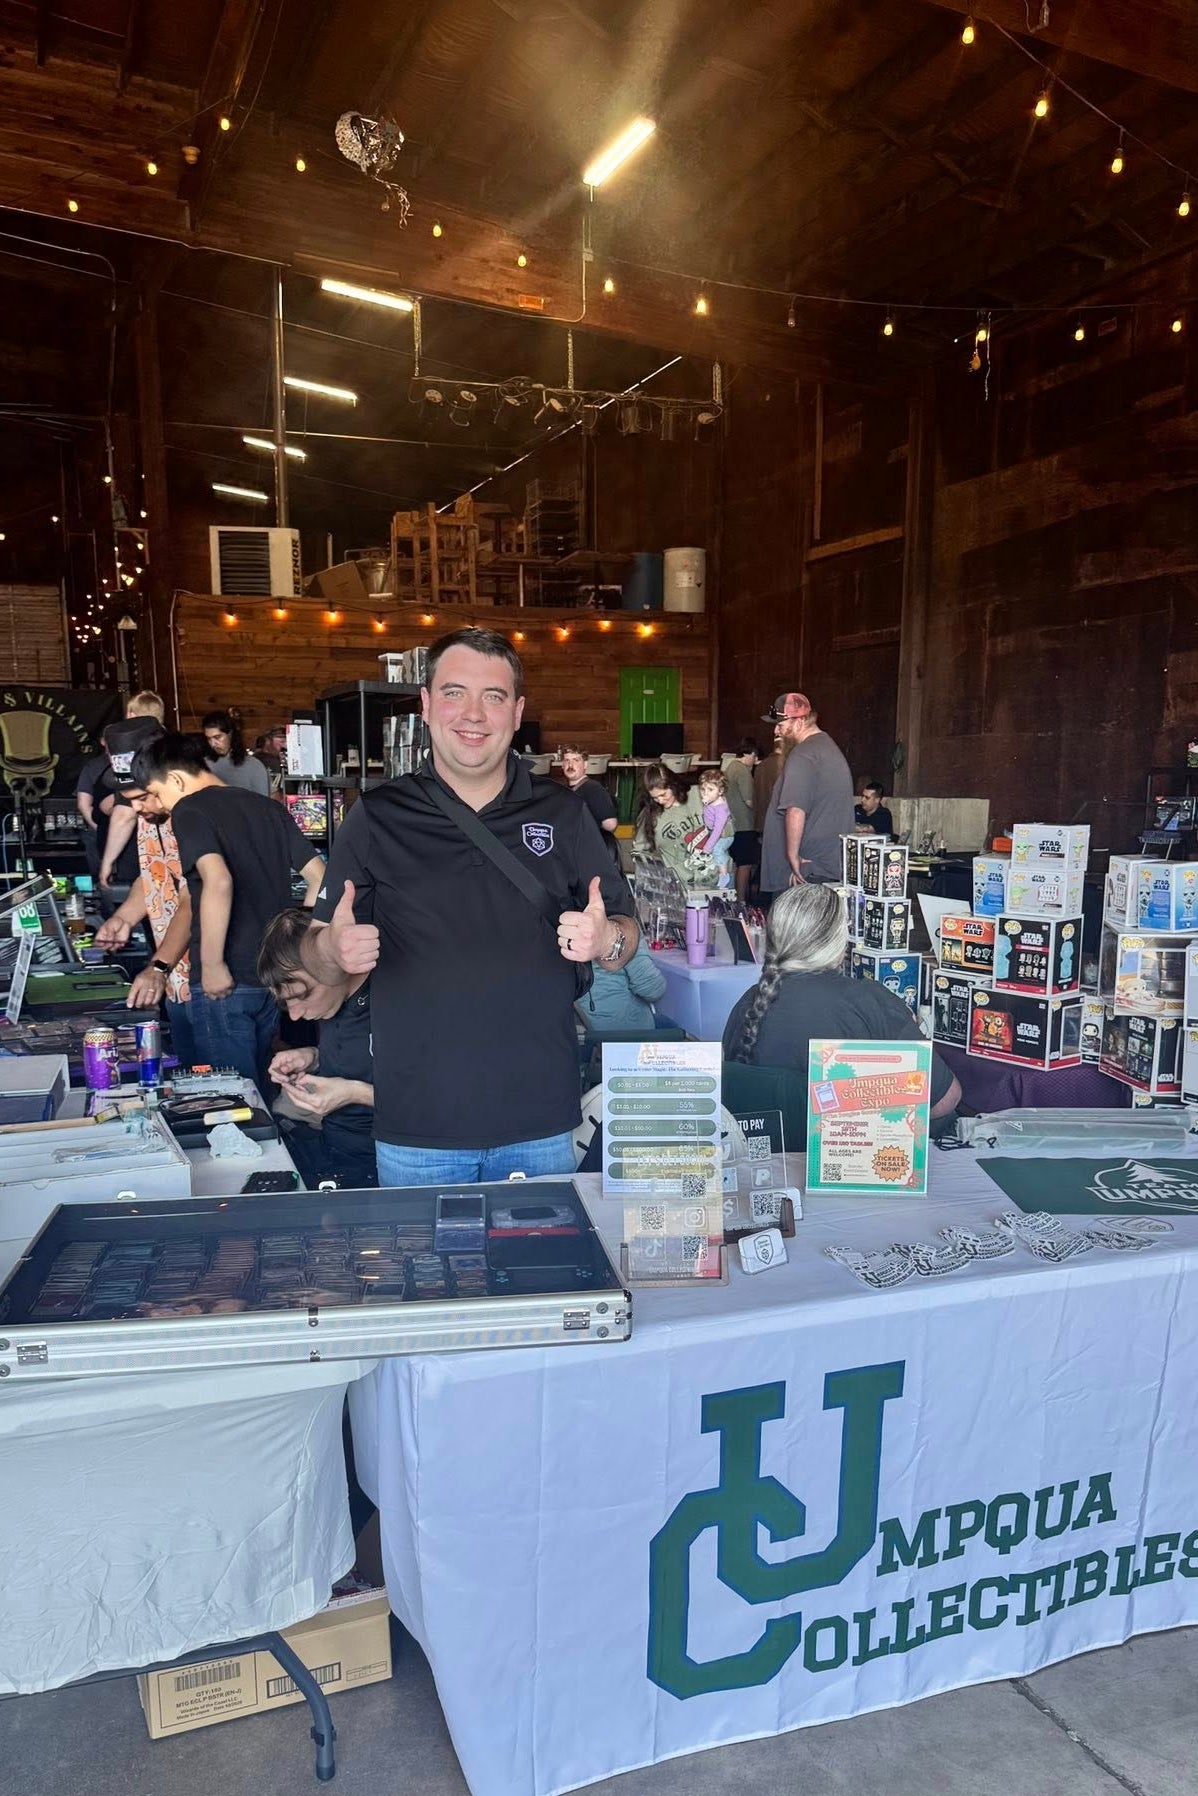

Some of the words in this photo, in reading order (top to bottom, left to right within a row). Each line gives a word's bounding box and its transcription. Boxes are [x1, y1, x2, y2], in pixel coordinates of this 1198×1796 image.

[292, 538, 301, 595] REZNOR
[24, 692, 94, 753] VILLAINS
[849, 1077, 898, 1089] Umpqua
[861, 1098, 890, 1109] Expo
[738, 1120, 748, 1131] TO
[750, 1118, 765, 1130] PAY
